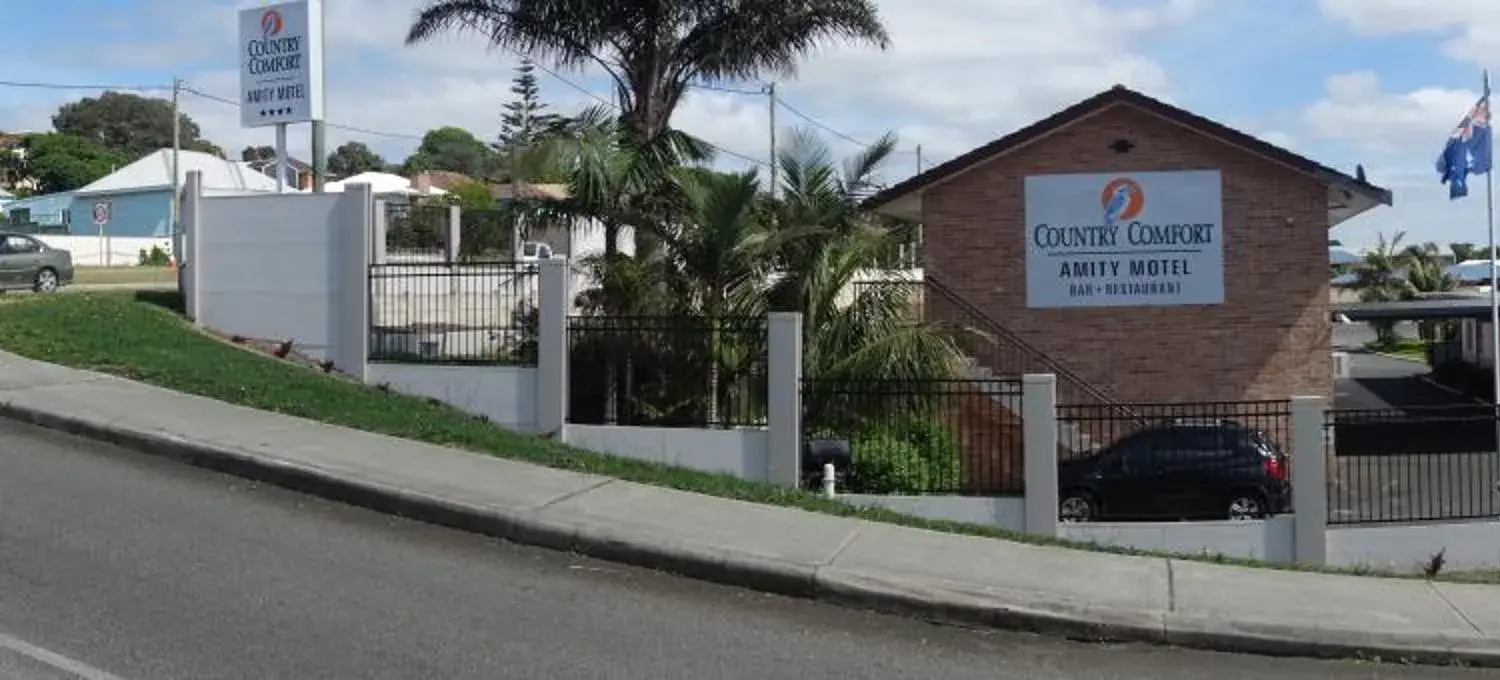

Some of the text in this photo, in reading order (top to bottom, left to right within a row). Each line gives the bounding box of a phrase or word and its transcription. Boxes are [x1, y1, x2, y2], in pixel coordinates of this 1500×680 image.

[247, 36, 301, 56] COUNTRY
[247, 54, 301, 75] COMFORT
[1034, 221, 1215, 248] COUNTRY COMFORT
[1059, 258, 1193, 278] AMITY MOTEL
[1069, 281, 1181, 297] BAR RESTAURANT
